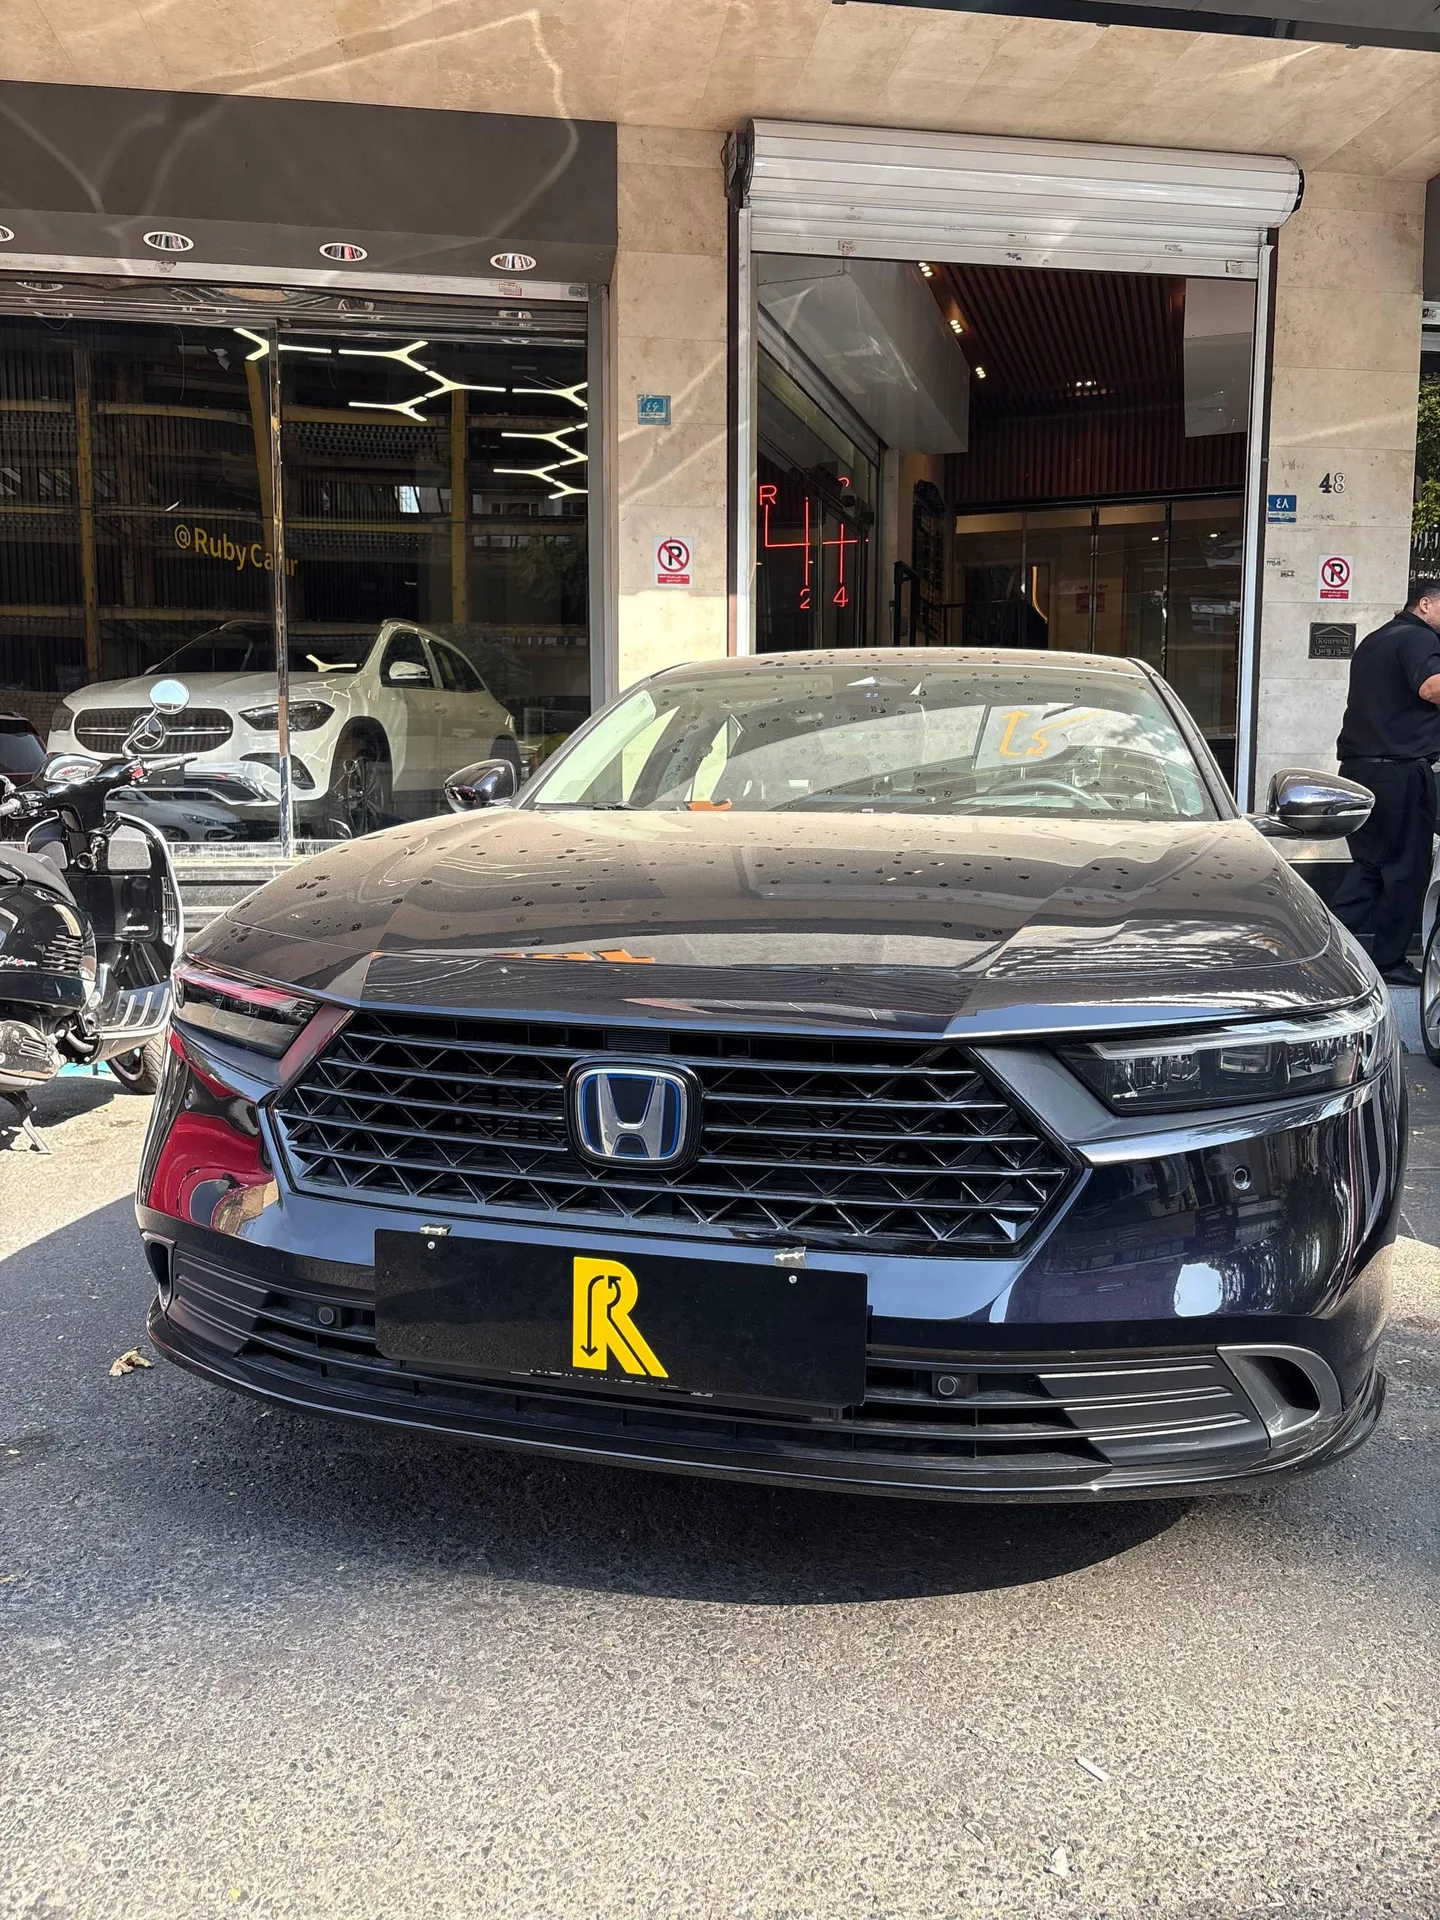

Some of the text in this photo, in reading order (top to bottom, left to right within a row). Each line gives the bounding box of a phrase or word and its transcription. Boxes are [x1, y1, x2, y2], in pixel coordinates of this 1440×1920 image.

[1318, 471, 1347, 494] 48
[759, 485, 777, 506] R
[832, 586, 849, 608] 4
[572, 1256, 669, 1378] R
